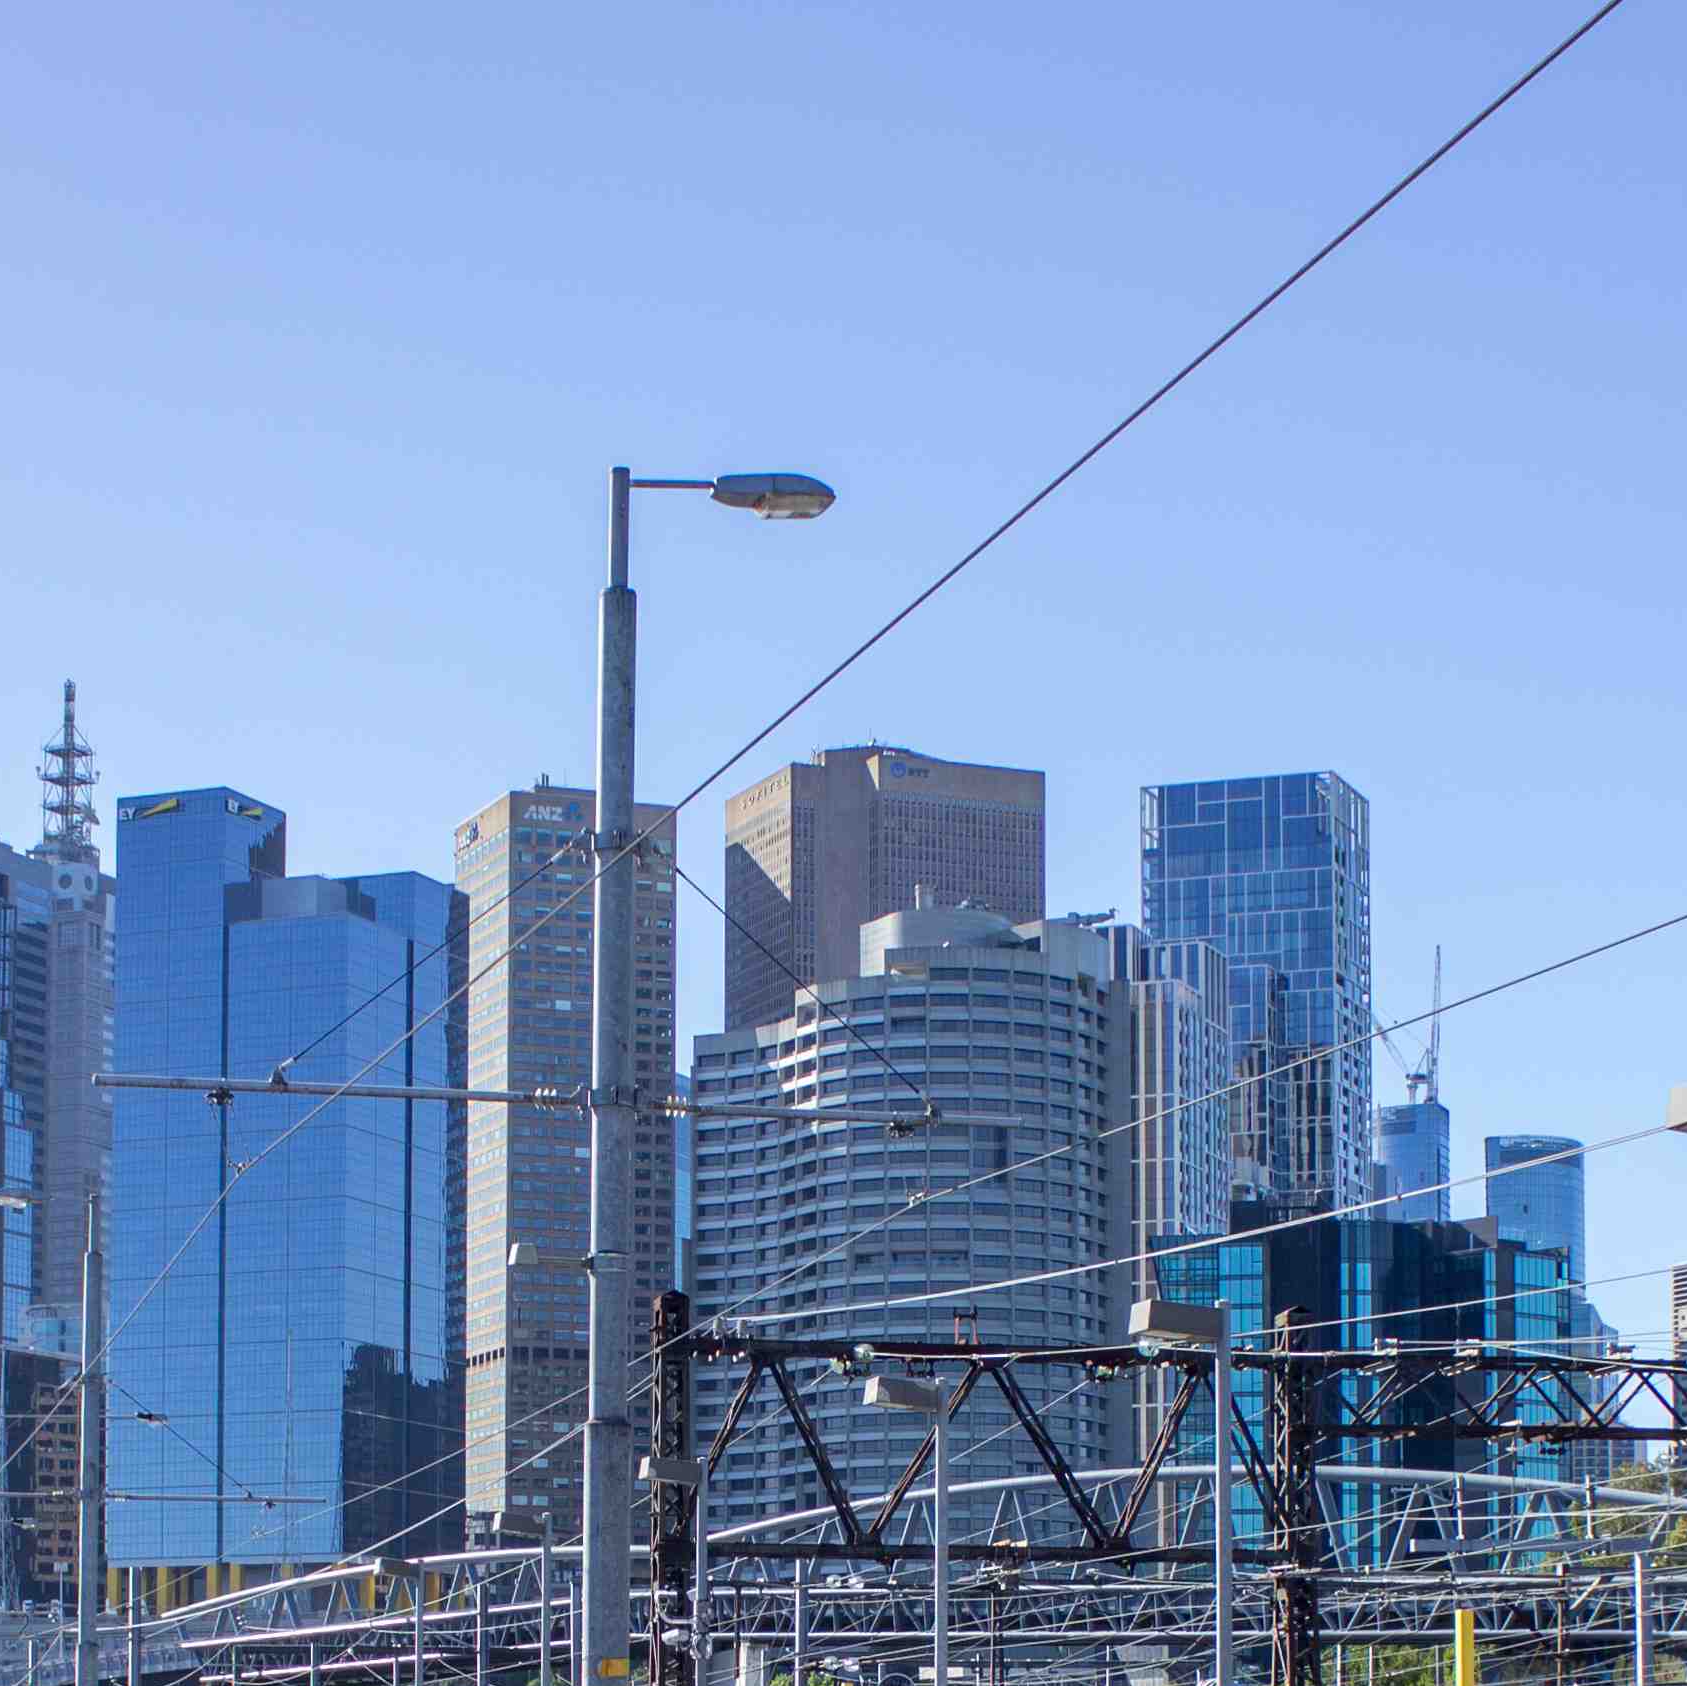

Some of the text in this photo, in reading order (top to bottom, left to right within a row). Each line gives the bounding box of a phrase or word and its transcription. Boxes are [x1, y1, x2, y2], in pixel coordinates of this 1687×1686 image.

[228, 799, 240, 813] EY
[523, 804, 563, 821] ANZ
[120, 807, 137, 820] EY
